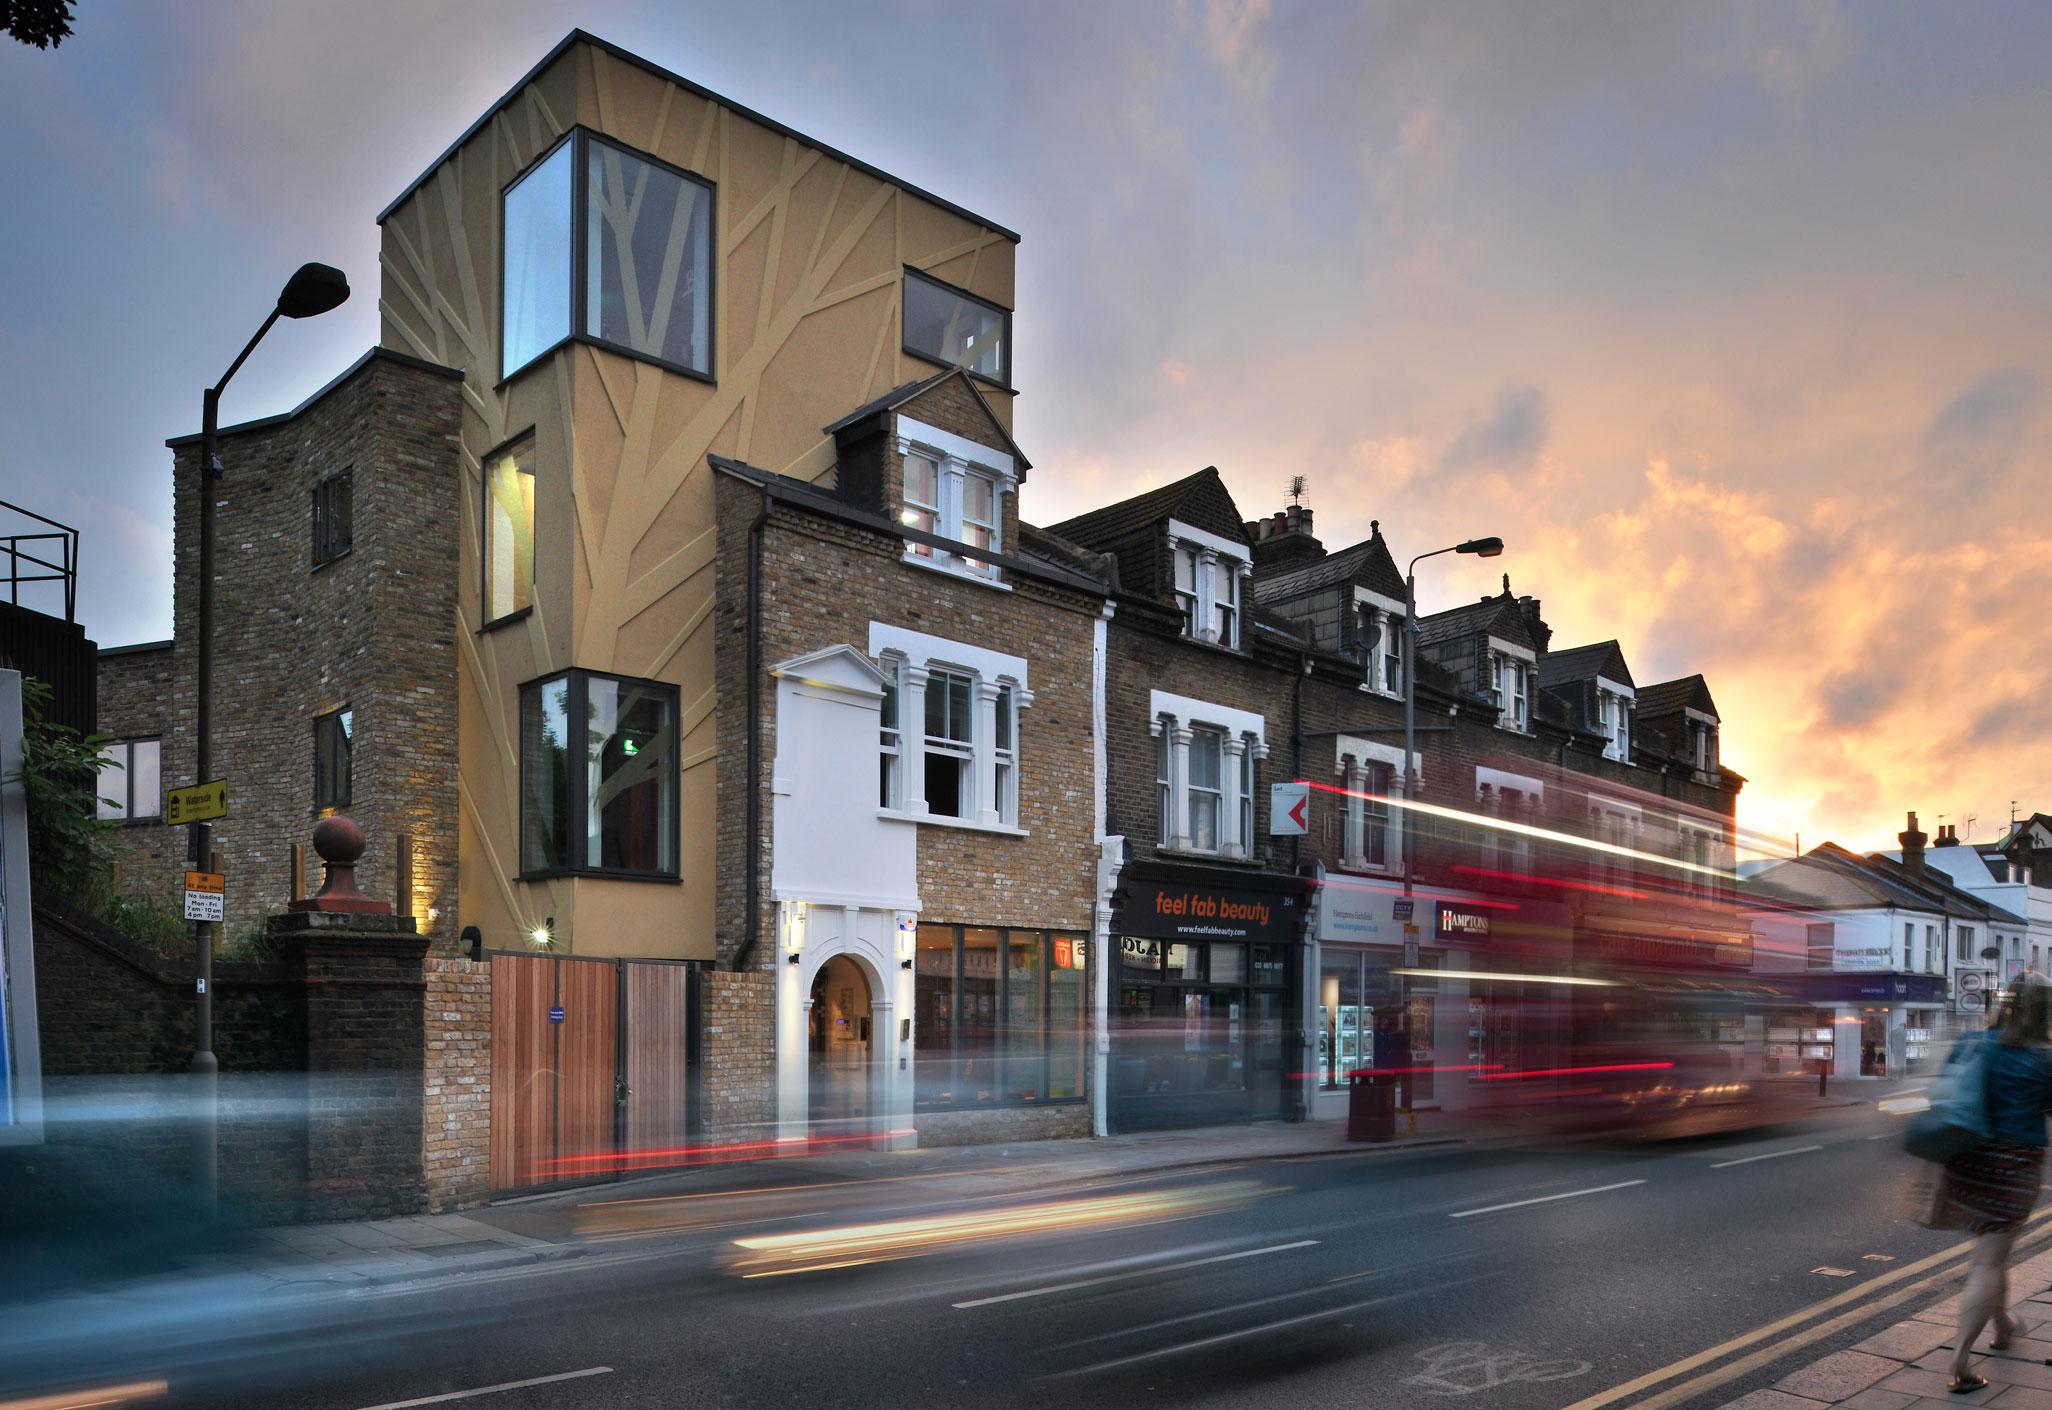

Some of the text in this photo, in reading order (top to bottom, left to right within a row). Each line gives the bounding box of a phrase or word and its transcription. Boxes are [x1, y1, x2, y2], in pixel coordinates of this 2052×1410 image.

[1156, 891, 1270, 926] feel fab beauty
[1177, 924, 1247, 937] www.feelfabbeauty.com
[1442, 910, 1490, 932] HAMPTONS
